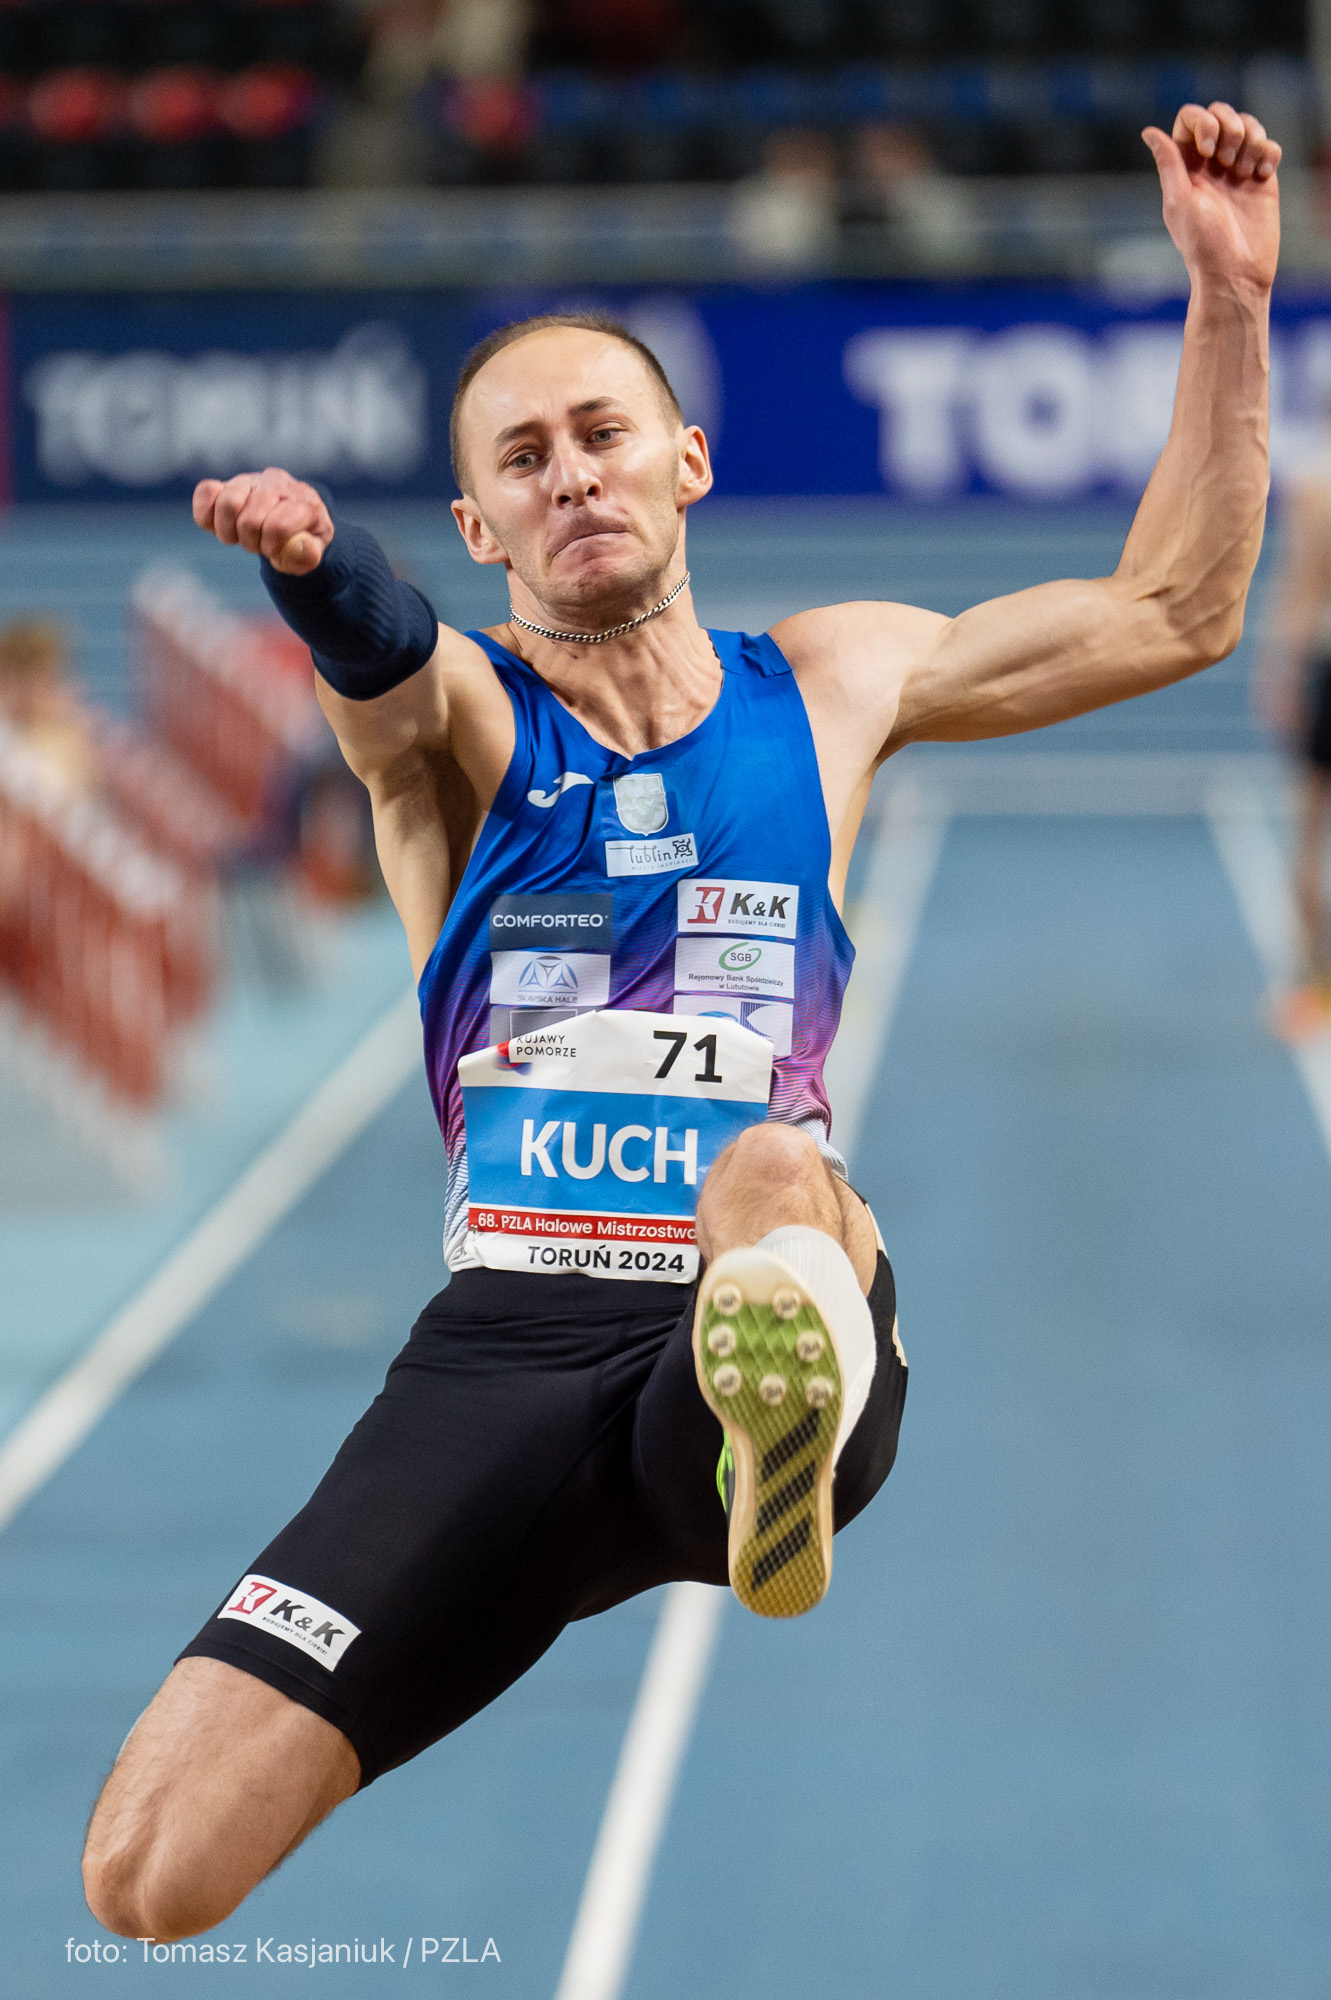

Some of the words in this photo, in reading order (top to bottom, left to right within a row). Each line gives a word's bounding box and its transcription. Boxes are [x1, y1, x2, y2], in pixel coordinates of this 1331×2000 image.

[730, 892, 791, 919] K&K
[492, 914, 604, 928] COMFORTEO
[730, 952, 752, 962] SGB
[688, 973, 725, 982] Rejonowy
[726, 974, 744, 982] Bank
[726, 983, 760, 991] Lututowie
[554, 996, 578, 1004] HALE
[516, 1034, 566, 1045] KUJAWY
[516, 1046, 577, 1058] POMORZE
[653, 1030, 723, 1084] 71
[520, 1118, 699, 1186] KUCH
[478, 1212, 499, 1228] 68.
[501, 1215, 533, 1231] PZLA
[535, 1217, 593, 1234] Halowe
[527, 1244, 611, 1269] TORUŃ
[618, 1250, 685, 1273] 2024
[269, 1598, 346, 1648] K&K
